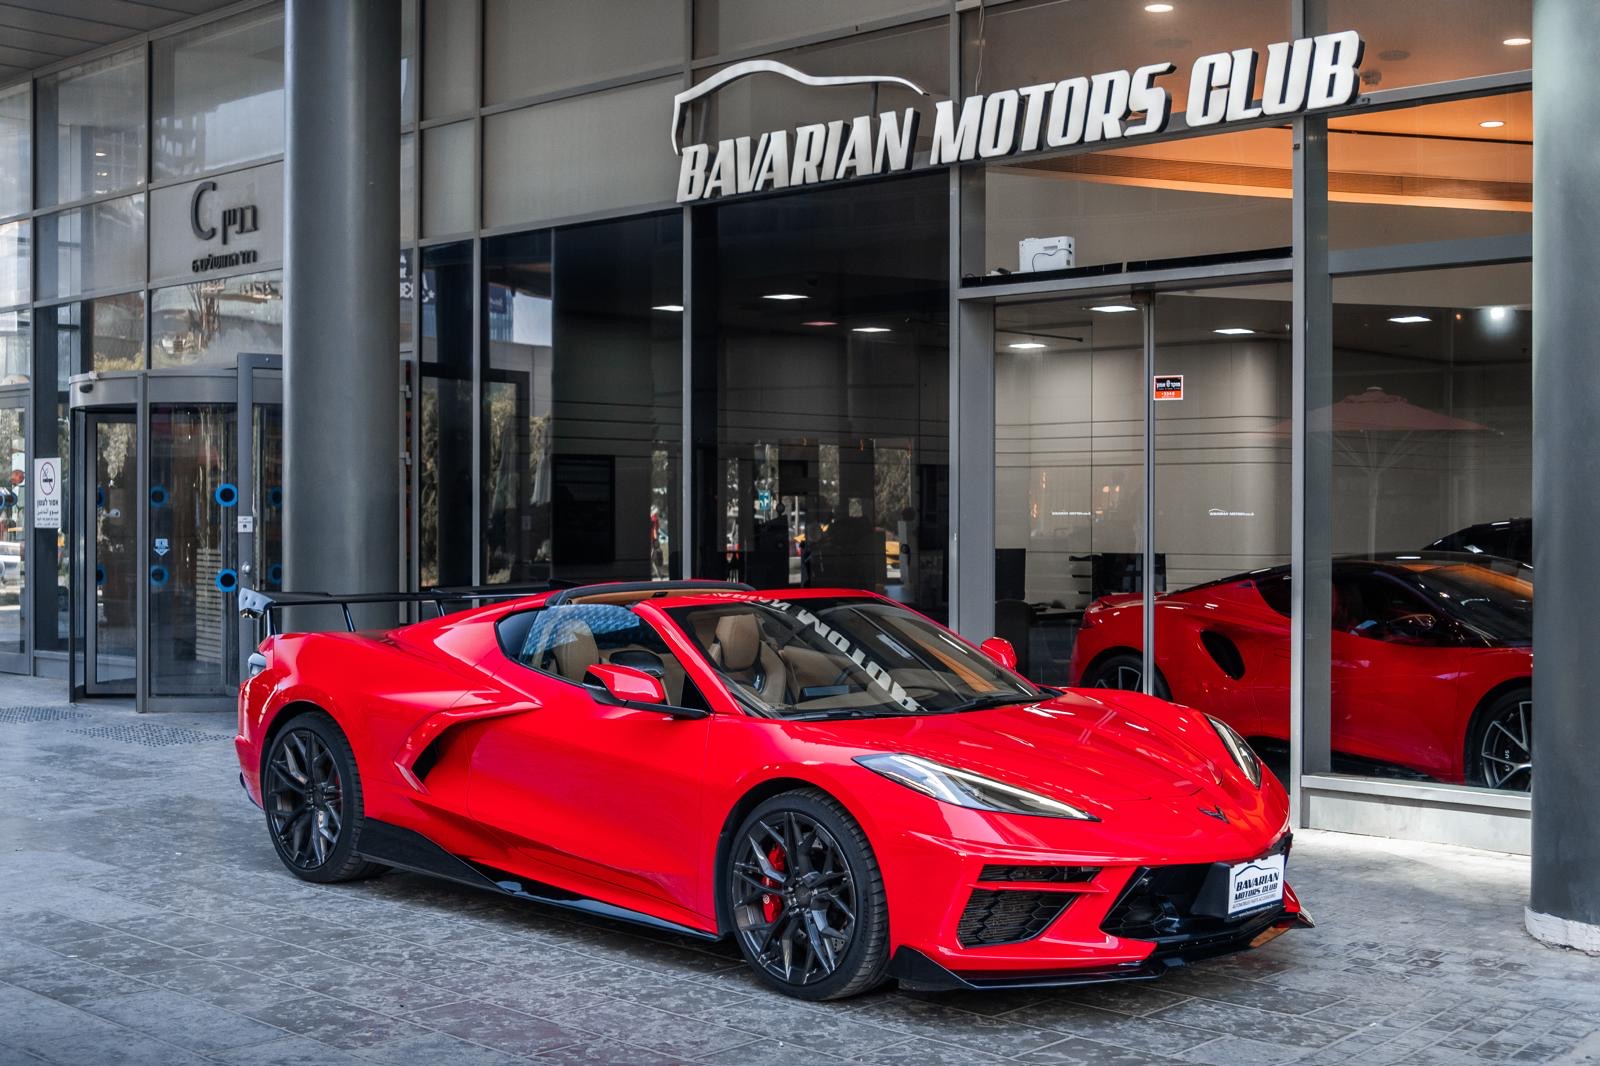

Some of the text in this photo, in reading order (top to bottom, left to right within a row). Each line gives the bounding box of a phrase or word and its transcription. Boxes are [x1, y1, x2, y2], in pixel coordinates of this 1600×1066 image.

[677, 30, 1365, 203] BAVARIAN MOTORS CLUB
[190, 181, 217, 241] C
[191, 258, 200, 273] 6
[1234, 882, 1278, 900] MOTORS CLUB
[1236, 872, 1280, 892] BAVARIAN
